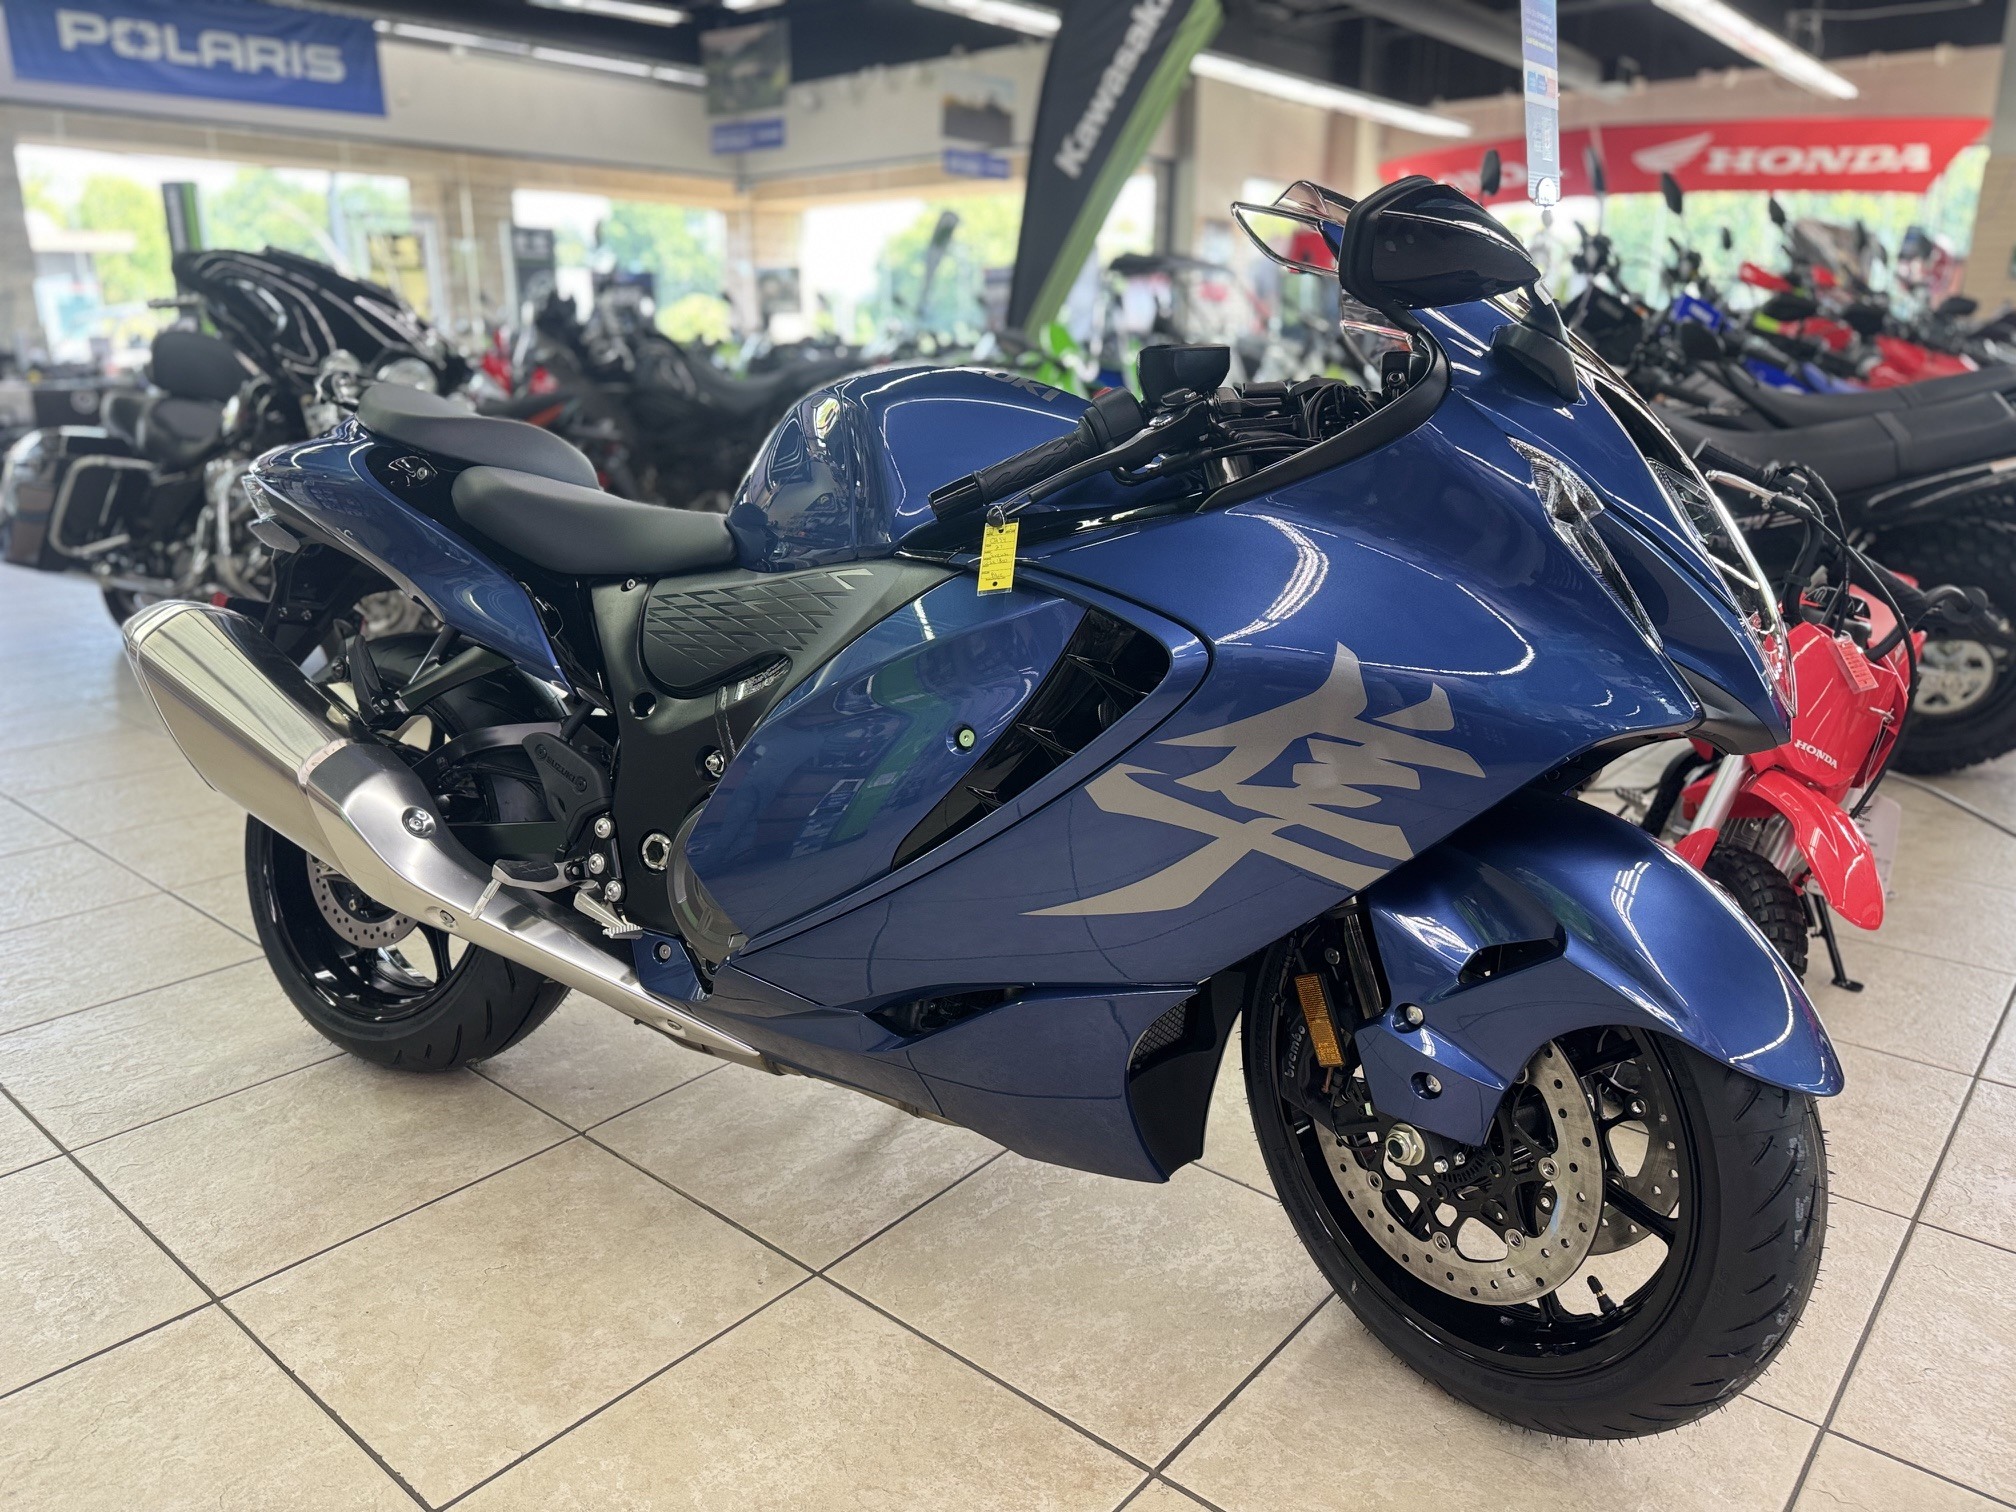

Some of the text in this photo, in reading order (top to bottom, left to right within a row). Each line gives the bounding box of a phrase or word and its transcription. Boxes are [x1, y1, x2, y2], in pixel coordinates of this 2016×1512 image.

[56, 9, 347, 84] POLARIS
[1053, 0, 1173, 179] Kawasak
[1704, 142, 1931, 176] HONDA
[1793, 739, 1838, 769] HONDA
[1284, 1025, 1306, 1078] brembo
